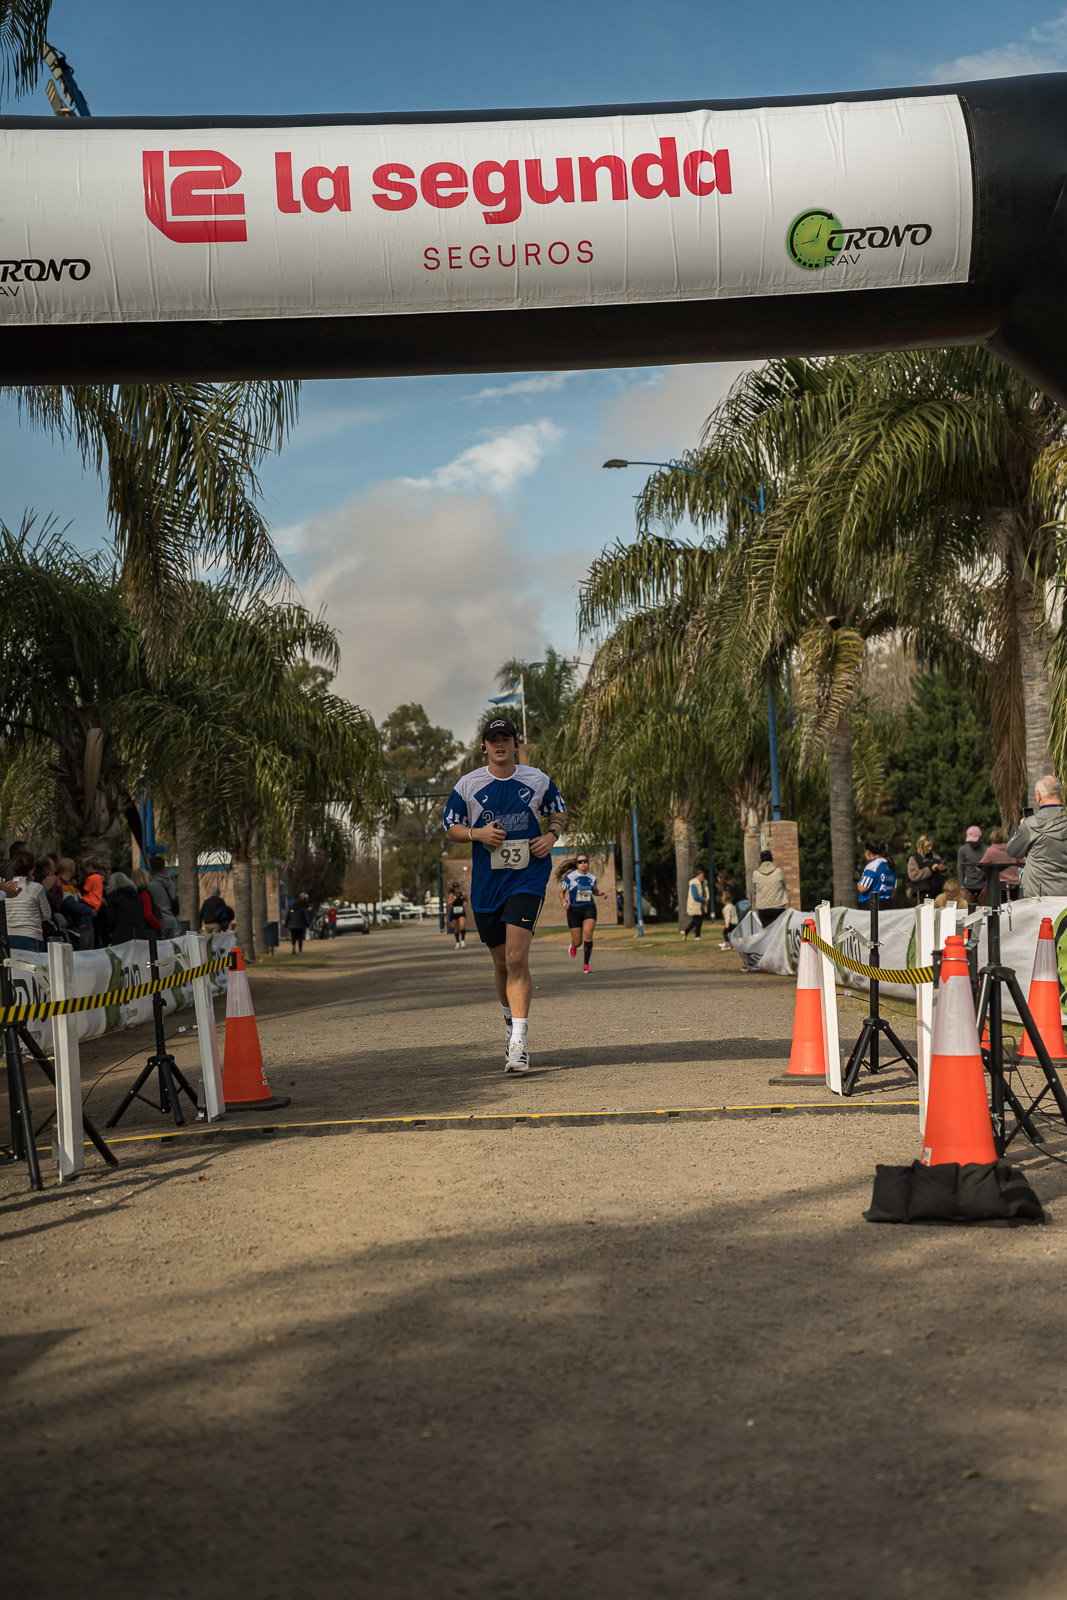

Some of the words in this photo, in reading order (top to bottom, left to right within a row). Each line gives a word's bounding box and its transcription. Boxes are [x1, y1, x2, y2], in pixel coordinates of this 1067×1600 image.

[275, 151, 351, 213] la
[372, 136, 732, 225] segunda
[827, 223, 933, 251] CRONO
[424, 240, 594, 270] SEGUROS
[824, 253, 861, 266] RAV
[0, 258, 91, 282] RONO
[0, 286, 19, 297] AV
[500, 848, 522, 864] 93
